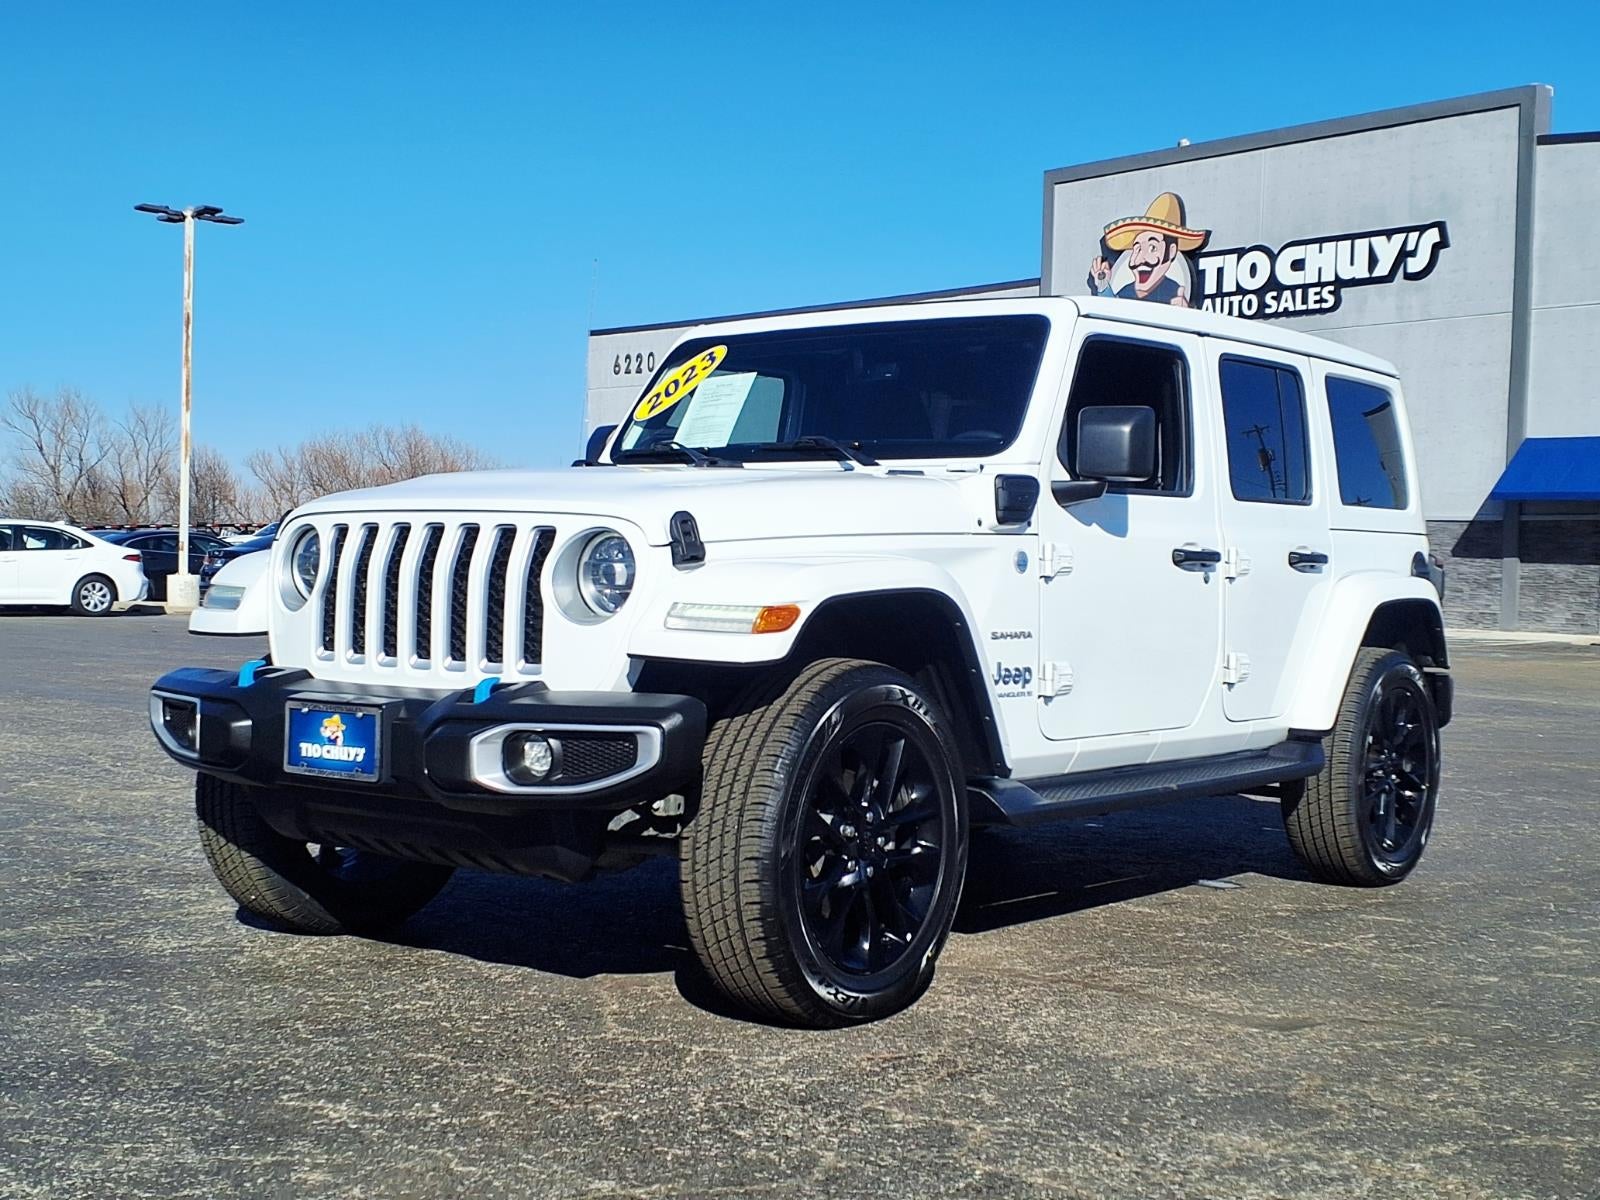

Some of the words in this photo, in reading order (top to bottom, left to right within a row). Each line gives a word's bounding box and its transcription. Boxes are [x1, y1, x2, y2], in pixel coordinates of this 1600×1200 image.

[1199, 250, 1271, 295] TIO
[1275, 227, 1441, 286] CHUY'S
[1201, 293, 1259, 316] AUTO
[1264, 285, 1335, 314] SALES
[613, 352, 655, 376] 6220
[647, 351, 717, 415] 2023
[991, 631, 1033, 640] SAHARA
[992, 661, 1033, 689] Jeep
[299, 742, 321, 758] TIO
